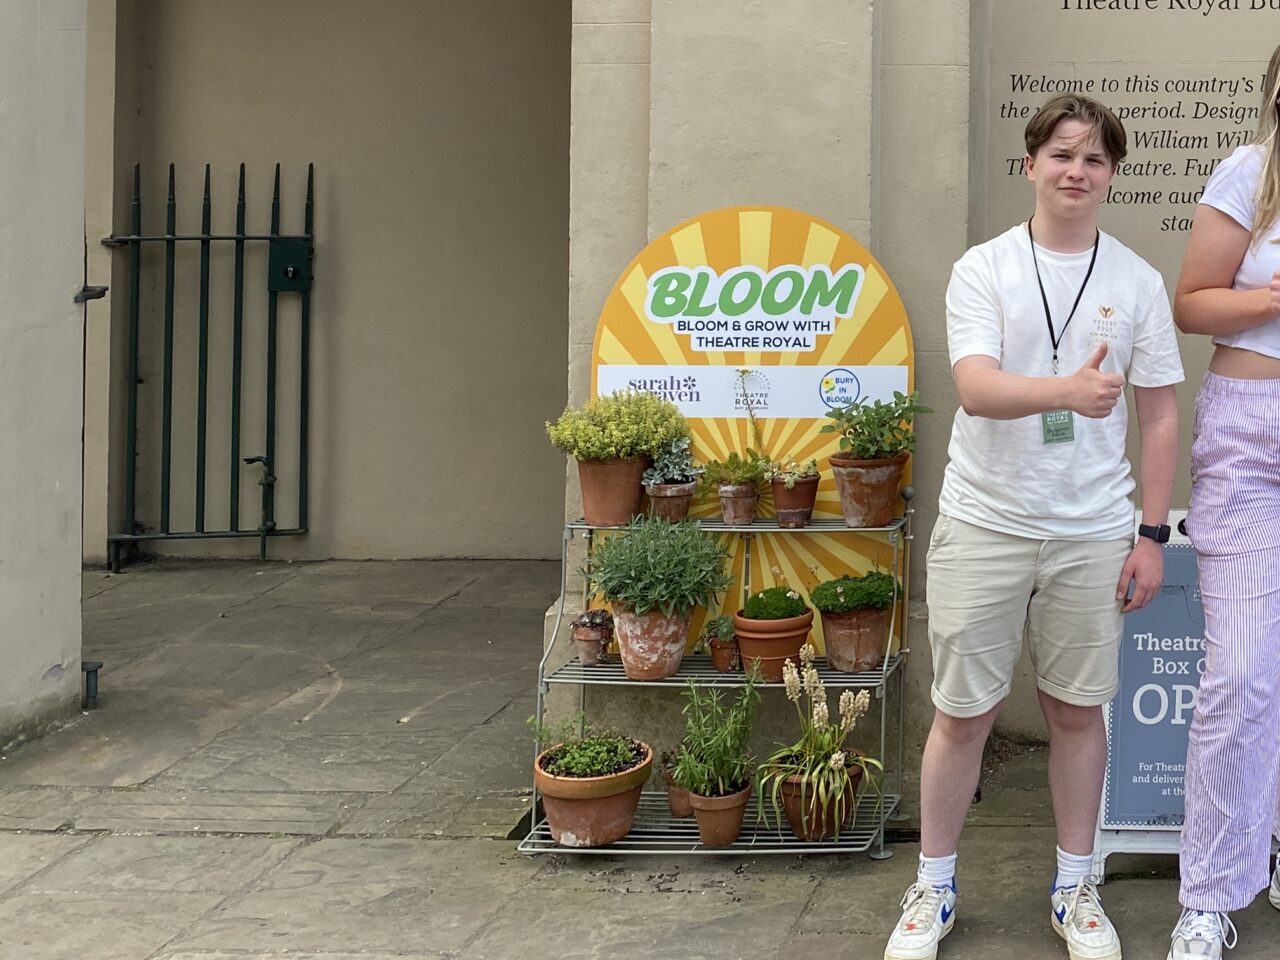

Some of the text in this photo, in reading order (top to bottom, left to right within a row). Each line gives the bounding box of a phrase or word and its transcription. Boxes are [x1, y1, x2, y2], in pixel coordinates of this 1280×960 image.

[1010, 74, 1094, 93] Welcome
[1101, 77, 1119, 93] to
[1125, 75, 1159, 93] this
[1000, 102, 1029, 119] the
[1118, 101, 1186, 120] period.
[1192, 102, 1259, 124] Design
[1133, 130, 1209, 149] William
[1104, 185, 1162, 205] lcome
[650, 269, 859, 317] BLOOM
[677, 320, 831, 332] BLOOM & GROW WITH
[696, 337, 811, 348] THEATRE ROYAL
[628, 375, 681, 390] sarah
[735, 398, 768, 406] ROYAL
[826, 395, 852, 403] BLOOM
[1133, 633, 1207, 651] Theatre
[1152, 657, 1190, 674] Box
[1132, 683, 1198, 725] OP
[1138, 762, 1185, 771] For Theatr
[1132, 774, 1185, 783] and deliver
[1161, 788, 1171, 796] at
